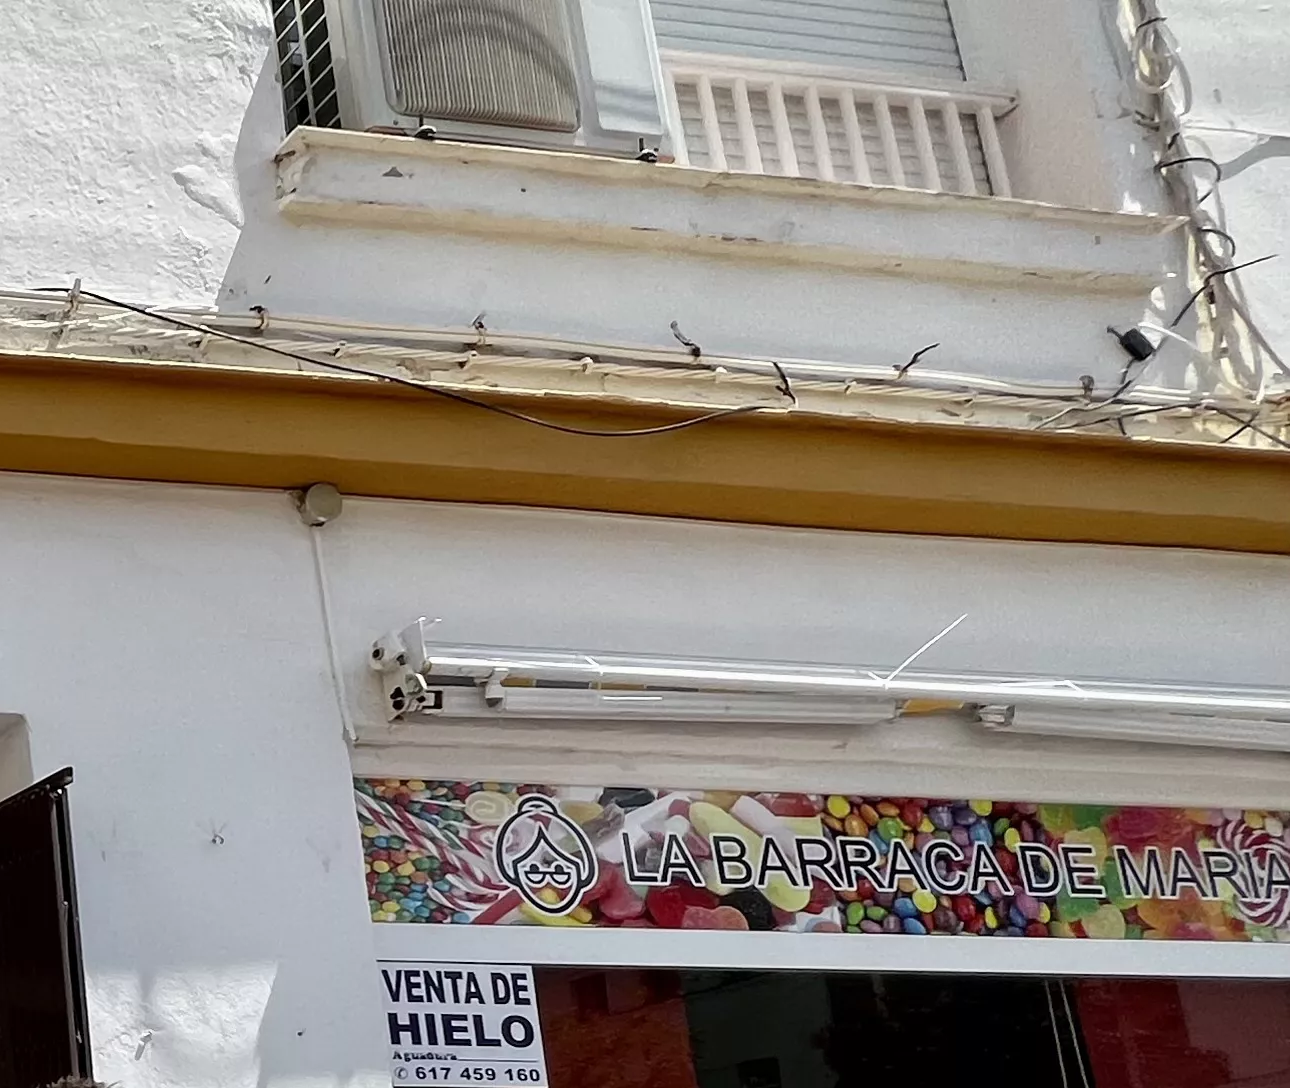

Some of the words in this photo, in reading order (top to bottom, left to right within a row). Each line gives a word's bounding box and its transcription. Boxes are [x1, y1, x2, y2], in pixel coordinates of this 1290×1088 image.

[619, 831, 705, 887] LA
[708, 833, 1015, 896] BARRACA
[1016, 841, 1107, 899] DE
[1113, 844, 1290, 901] MARIA
[381, 970, 486, 1004] VENTA
[490, 972, 531, 1005] DE
[387, 1012, 534, 1048] HIELO
[415, 1066, 452, 1080] 617
[460, 1067, 497, 1081] 459
[504, 1068, 540, 1082] 160
